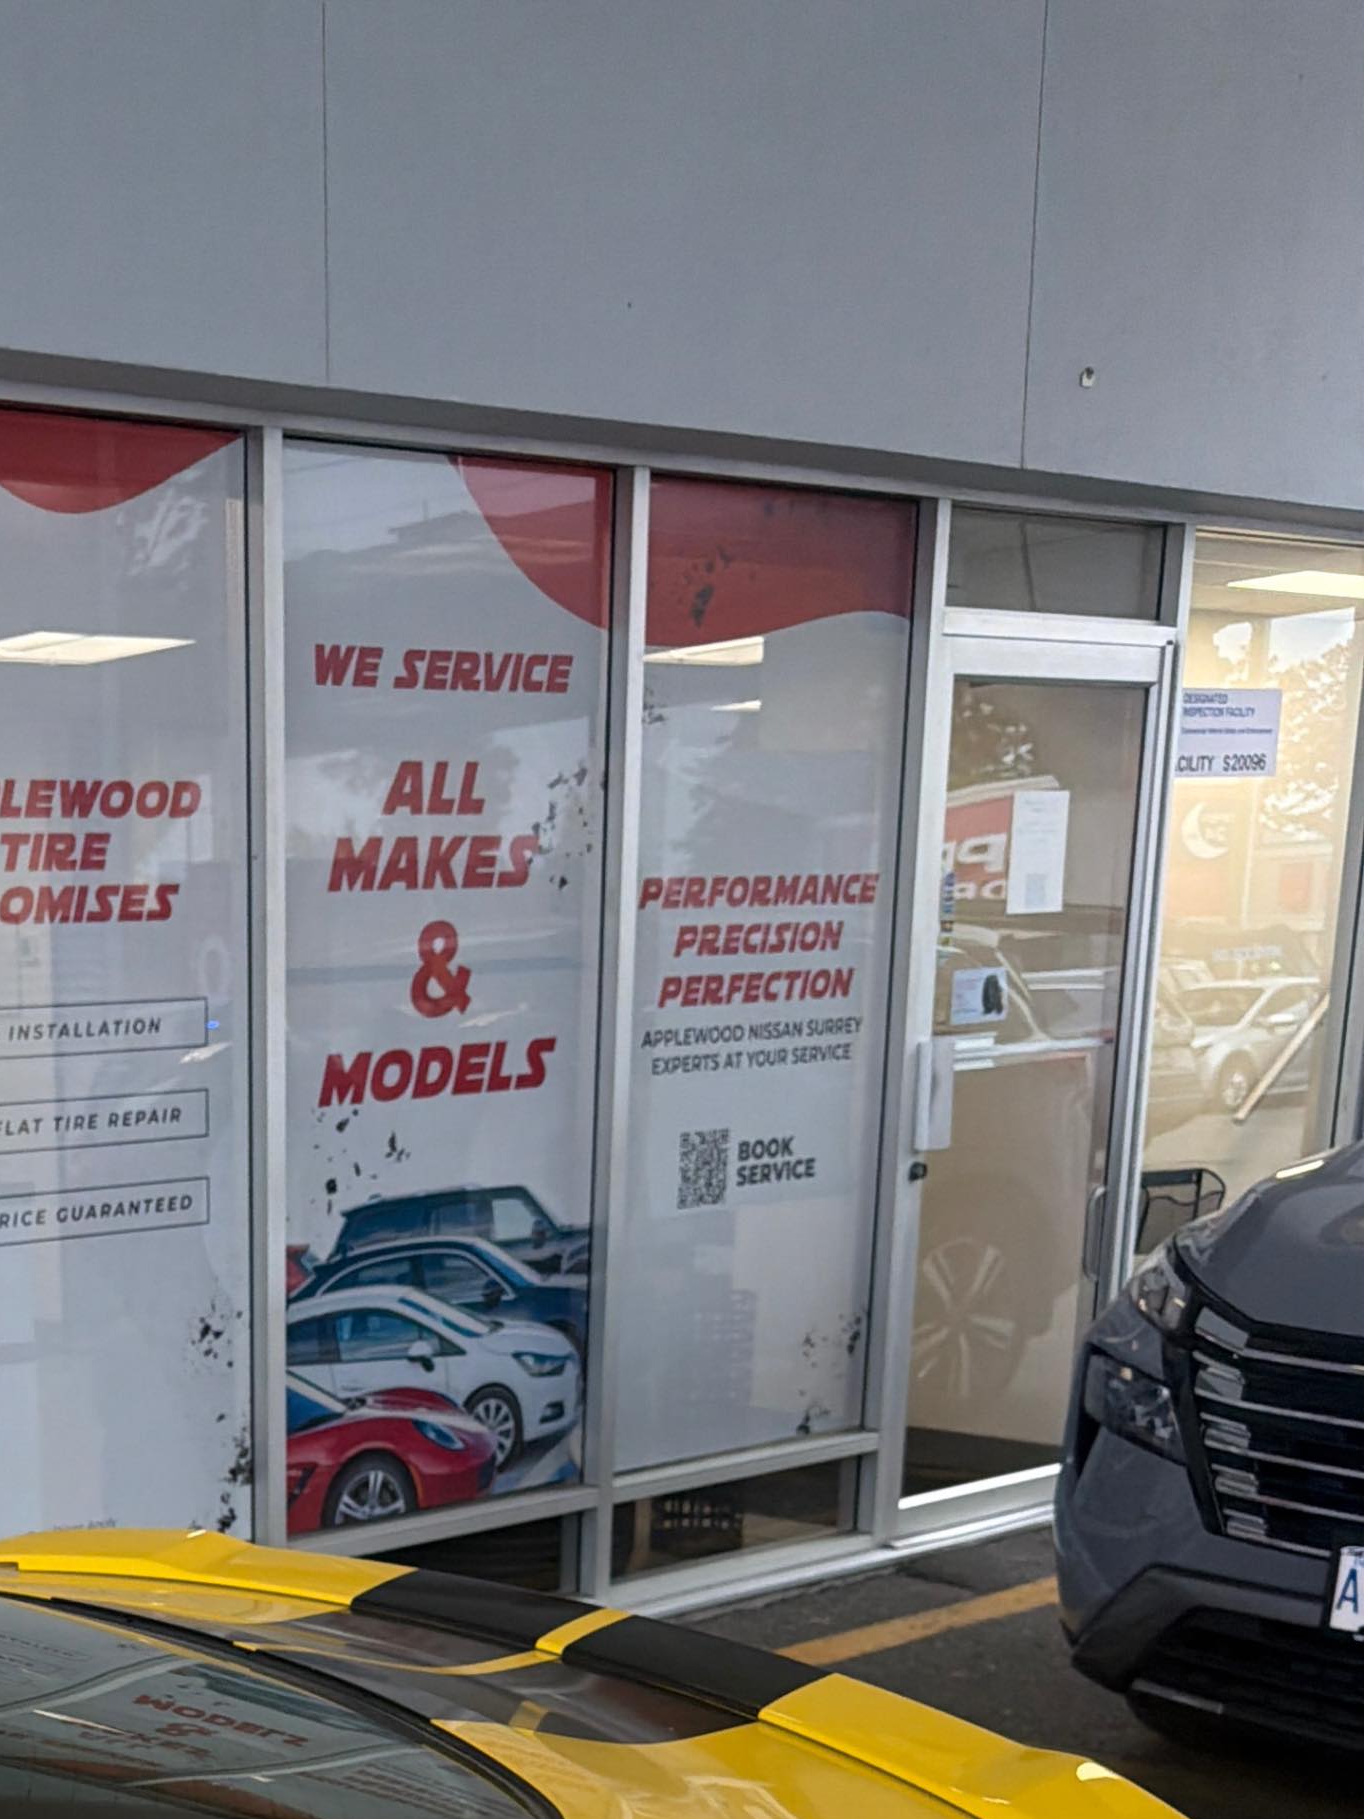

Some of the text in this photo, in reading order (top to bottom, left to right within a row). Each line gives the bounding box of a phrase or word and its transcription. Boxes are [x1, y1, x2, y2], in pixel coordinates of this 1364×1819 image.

[314, 644, 573, 694] WE SERVICE
[1222, 753, 1266, 772] S20096
[382, 761, 486, 816] ALL
[0, 832, 111, 872] TIRE
[327, 835, 541, 892] MAKES
[639, 873, 880, 909] PERFORMANCE
[673, 920, 844, 957] PRECISION
[410, 920, 473, 1018] &
[658, 968, 855, 1008] PERFECTION
[7, 1017, 162, 1041] INSTALLATION
[641, 1016, 863, 1048] APPLEWOOD NISSAN SURREY
[318, 1037, 557, 1108] MODELS
[652, 1044, 852, 1076] EXPERTS AT YOUR SERVICE
[52, 1112, 100, 1133] TIRE
[107, 1107, 183, 1129] REPAIR
[737, 1137, 794, 1161] BOOK
[736, 1158, 816, 1186] SERVICE
[56, 1194, 194, 1225] GUARANTEED
